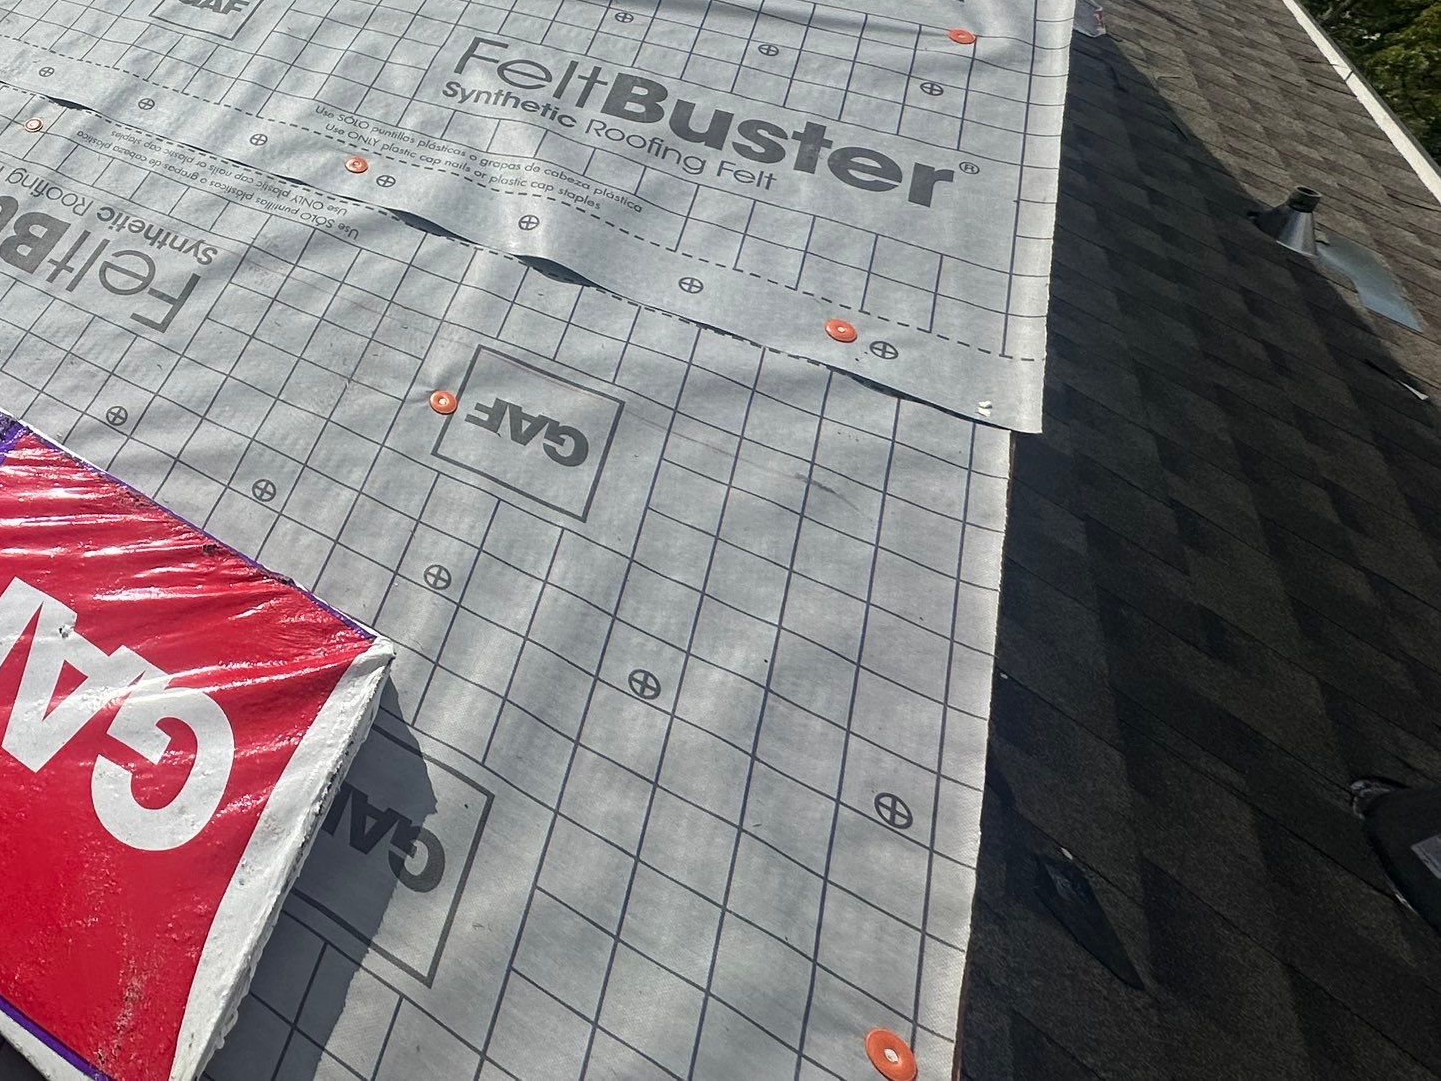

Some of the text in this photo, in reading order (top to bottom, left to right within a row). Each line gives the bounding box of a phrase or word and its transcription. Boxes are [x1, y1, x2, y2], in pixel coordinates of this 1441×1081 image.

[142, 138, 162, 152] cap
[442, 80, 777, 192] Synthetic Roofing Felt
[162, 145, 195, 165] plastic
[195, 158, 207, 168] or
[162, 161, 199, 181] grapas
[207, 163, 232, 179] nails
[233, 170, 254, 184] cap
[346, 130, 380, 149] ONLY
[380, 140, 417, 160] plastic
[418, 152, 441, 167] cap
[443, 157, 472, 173] nails
[472, 170, 487, 180] or
[488, 170, 527, 192] plastic
[529, 179, 555, 194] cap
[556, 186, 602, 210] staples
[370, 123, 416, 146] puntillas
[416, 135, 467, 160] plásticas
[478, 154, 521, 177] grapas
[542, 166, 592, 190] cabeza
[591, 184, 645, 212] plástica
[5, 169, 89, 218] Roofing
[207, 177, 254, 203] plásticas
[254, 177, 291, 199] plastic
[253, 193, 300, 217] puntillas
[290, 191, 324, 211] ONLY
[298, 208, 335, 230] SÓLO
[335, 221, 360, 239] Use
[98, 206, 218, 266] Synthetic
[465, 399, 589, 467] GAF
